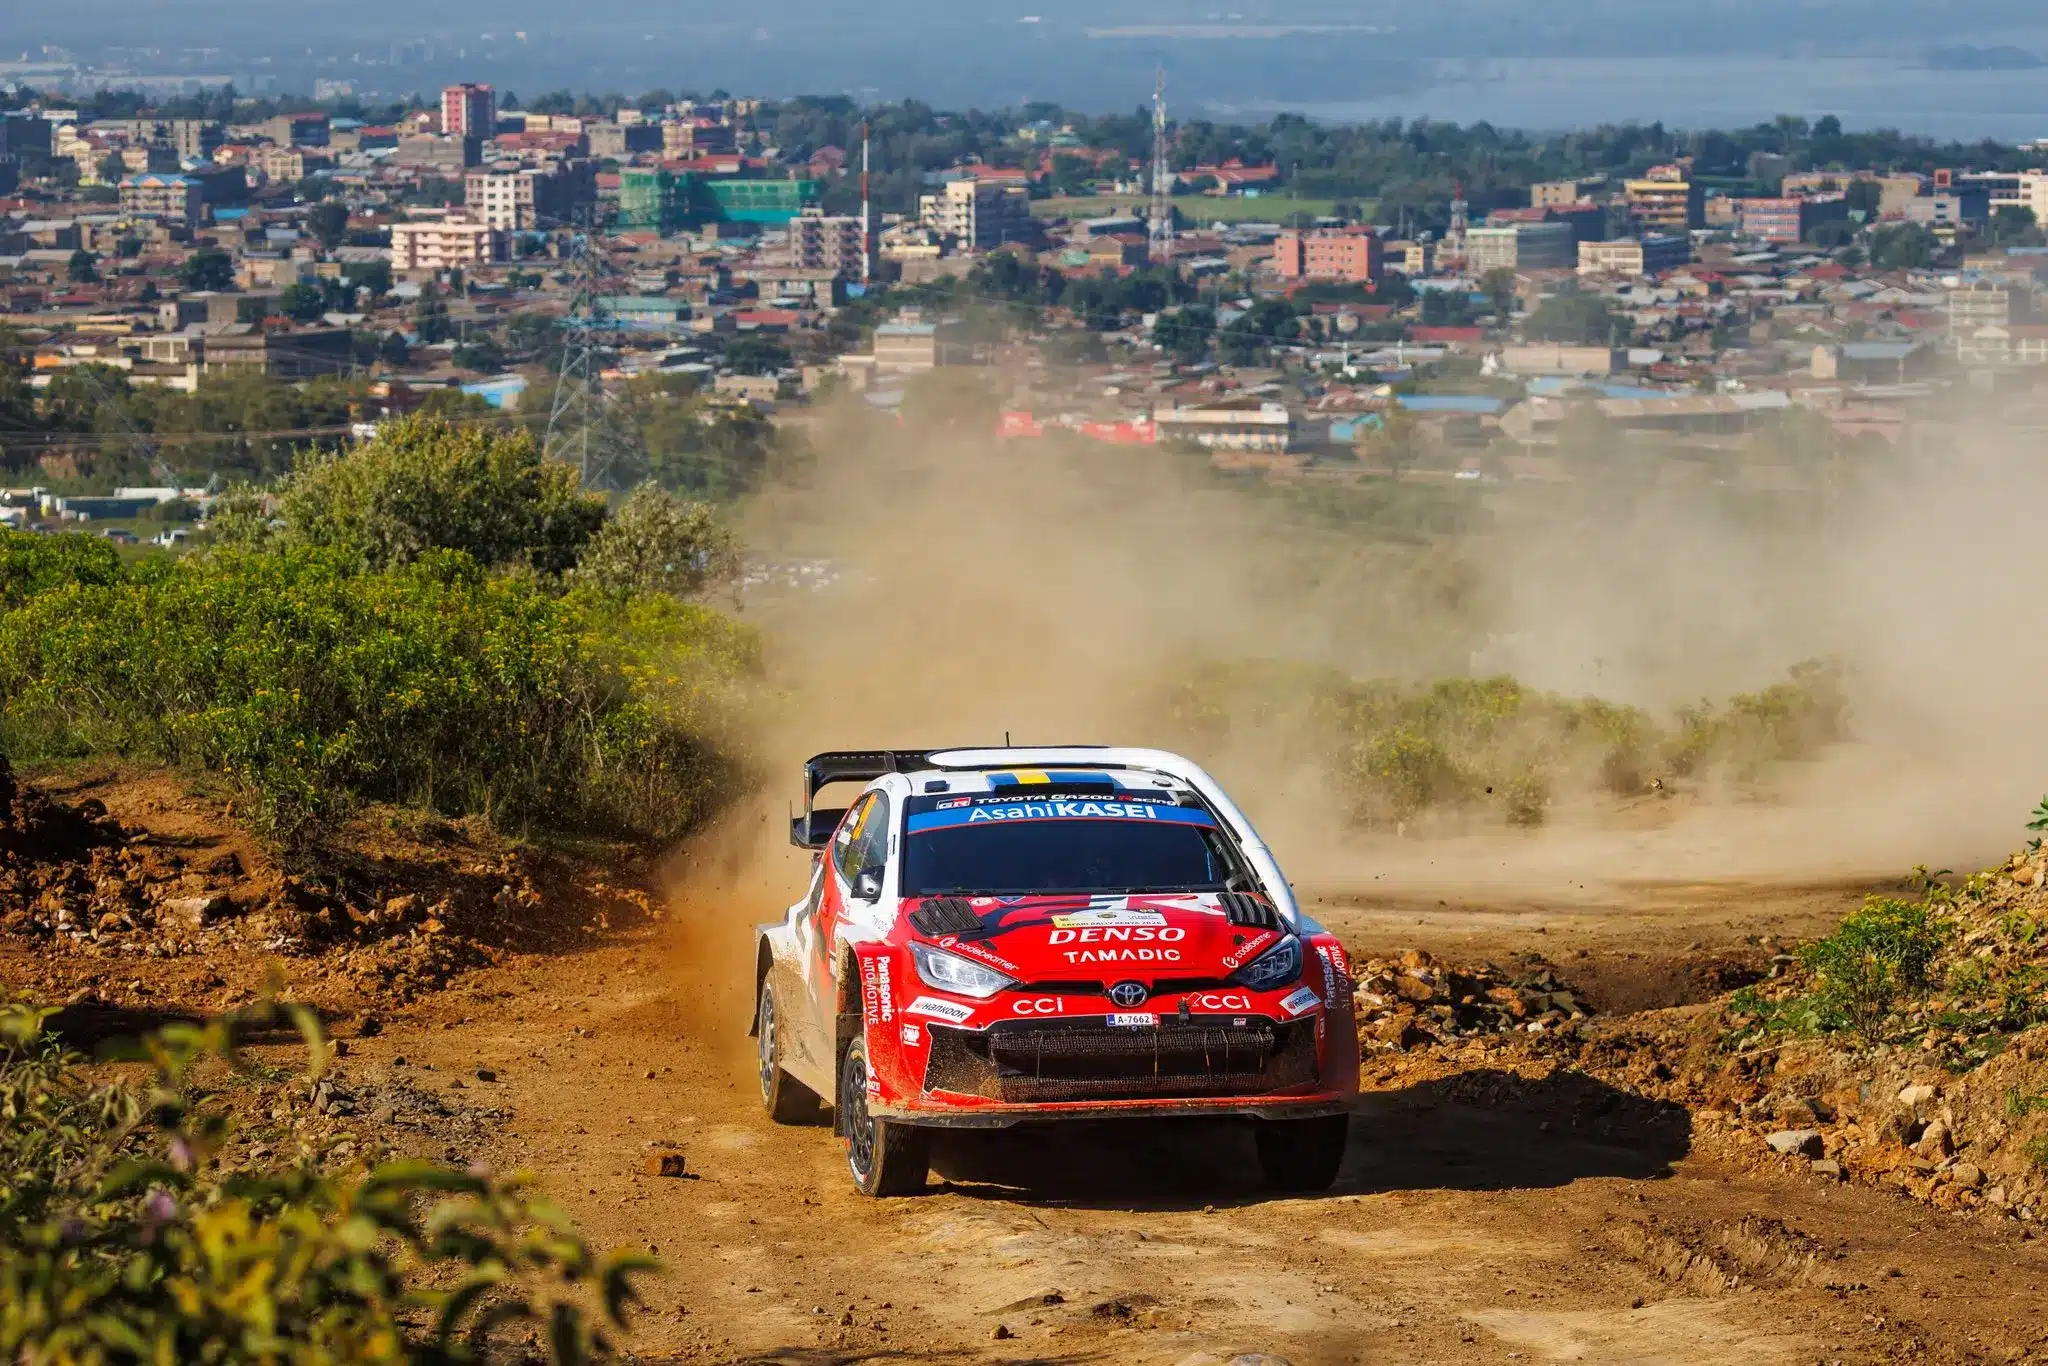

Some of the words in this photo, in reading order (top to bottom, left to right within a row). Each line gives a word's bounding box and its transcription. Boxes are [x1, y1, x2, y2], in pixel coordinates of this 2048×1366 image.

[937, 798, 971, 810] GR
[976, 795, 1046, 804] TOYOTA
[1051, 793, 1114, 802] GAZOO
[1117, 795, 1180, 806] Racing
[1048, 927, 1186, 944] DENSO
[1235, 931, 1271, 958] codebeamer
[956, 943, 1018, 971] codebeamer
[1063, 948, 1181, 963] TAMADIC
[862, 956, 878, 1025] AUTOMOTIVE
[877, 955, 892, 1022] Panasonic
[1117, 1015, 1150, 1024] A-7662
